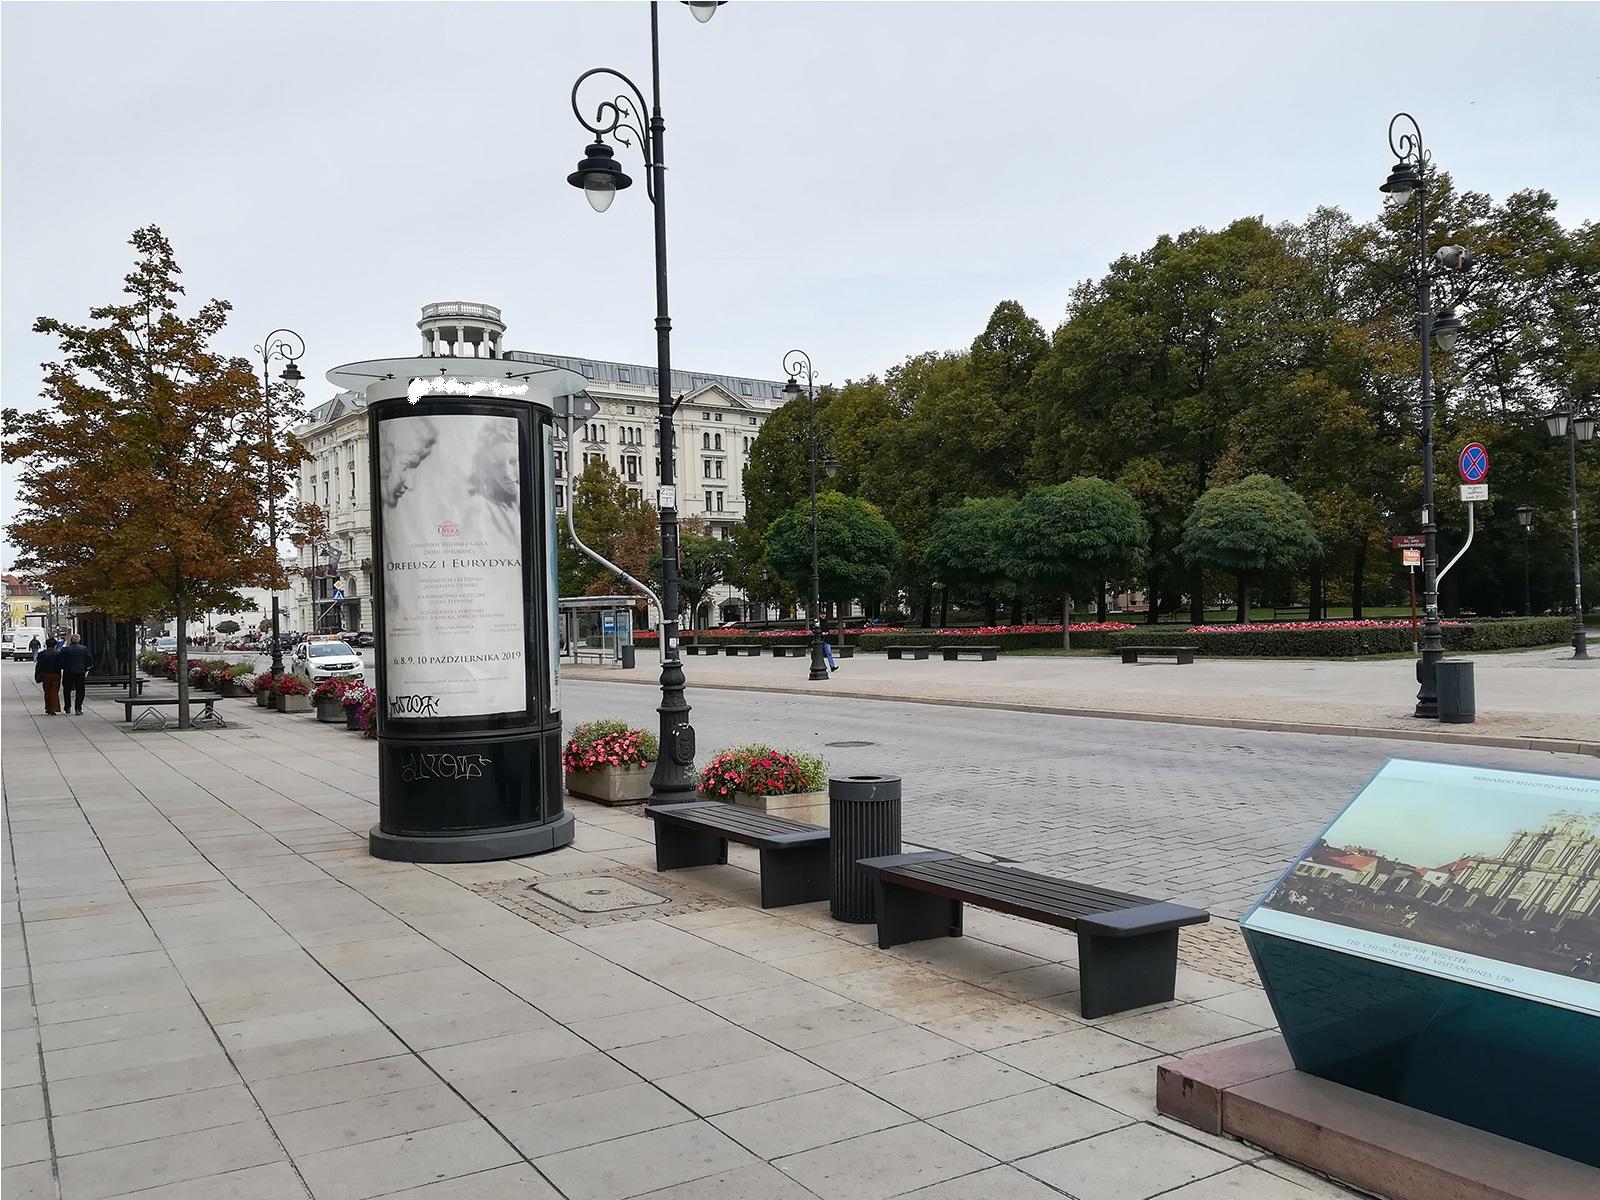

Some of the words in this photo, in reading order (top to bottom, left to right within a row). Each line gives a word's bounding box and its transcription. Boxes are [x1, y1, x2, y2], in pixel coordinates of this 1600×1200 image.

[386, 560, 437, 571] ORFEUSZ
[452, 558, 521, 568] EURYDYKA
[418, 656, 428, 664] 10
[430, 653, 500, 664] PAŹDZIERNIKA
[501, 651, 521, 661] 2019
[1346, 938, 1360, 946] THE
[1363, 942, 1398, 955] CHURCH
[1399, 950, 1412, 958] OF
[1414, 953, 1432, 963] THE
